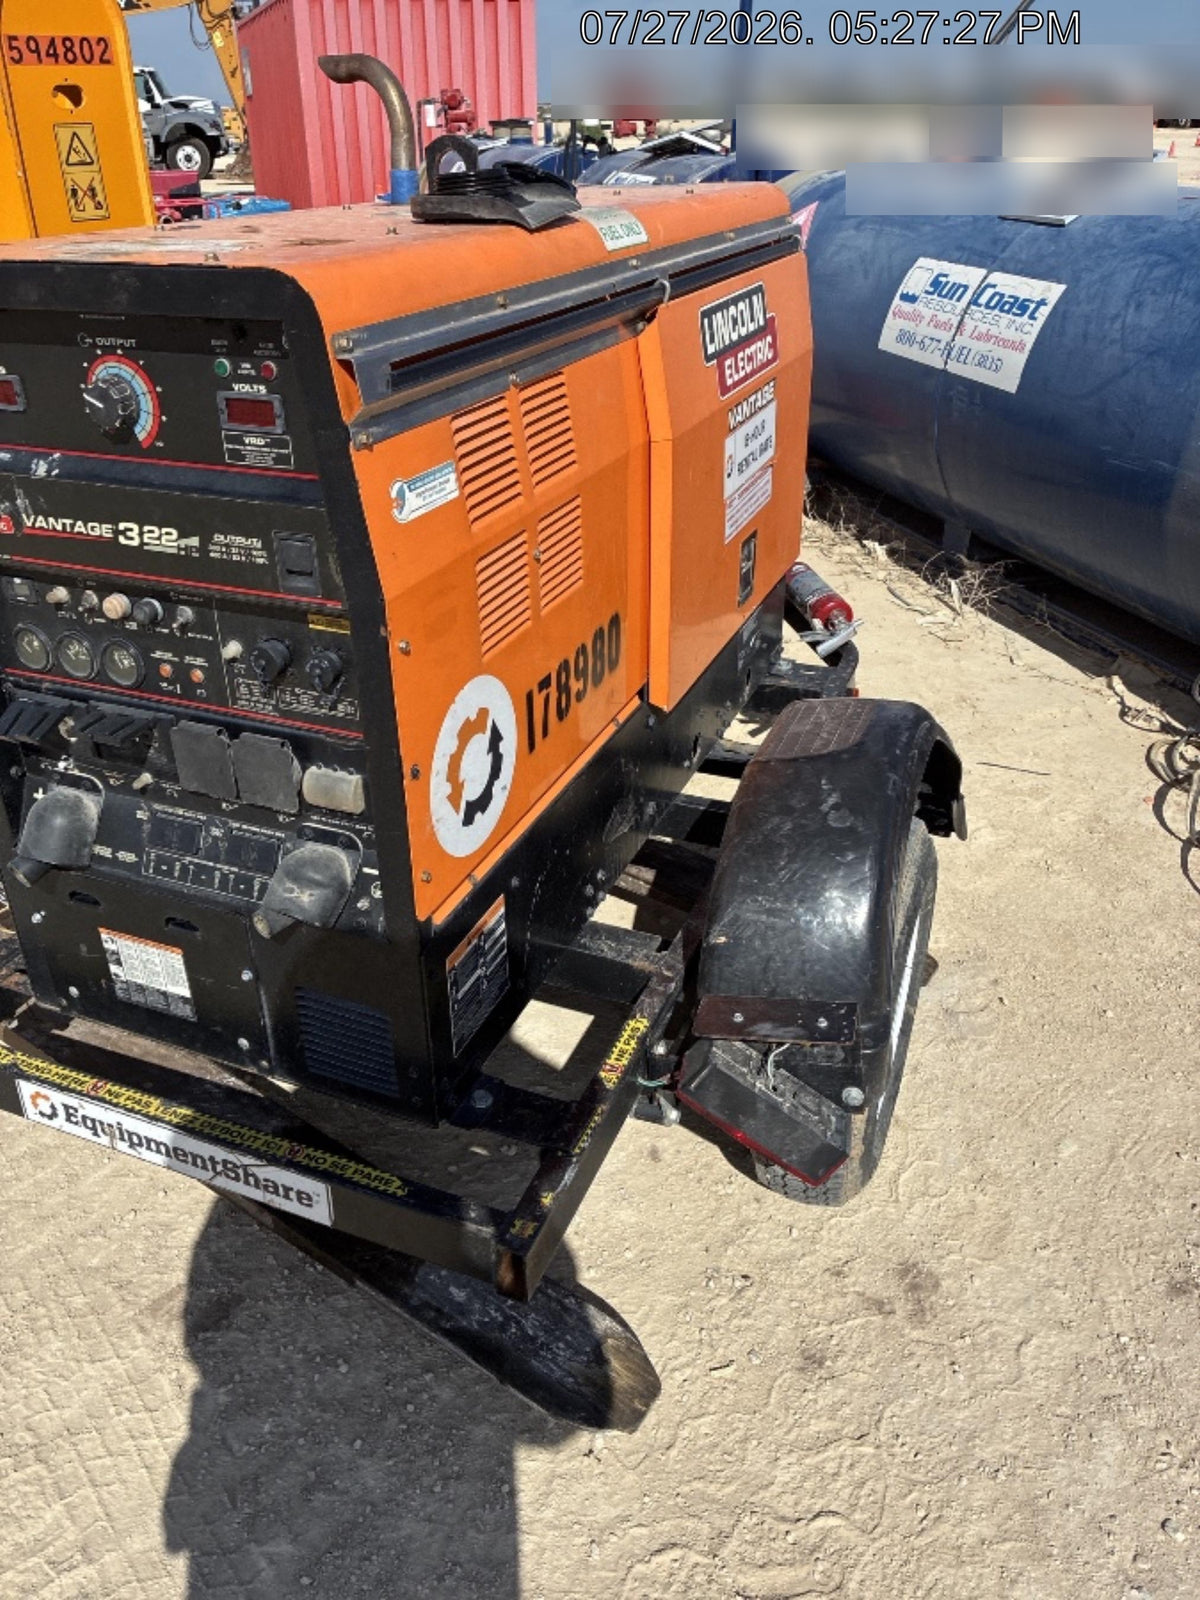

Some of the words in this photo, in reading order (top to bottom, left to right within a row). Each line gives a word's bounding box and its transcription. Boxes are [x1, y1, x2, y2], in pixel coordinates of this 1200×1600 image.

[7, 35, 112, 65] 594802
[925, 272, 970, 303] Sun
[970, 282, 1048, 321] Coast
[95, 337, 137, 348] OUTPUT
[704, 293, 765, 355] LINCOLN
[892, 303, 925, 327] Quality
[927, 313, 954, 333] Fuels
[968, 324, 1027, 354] Lubricants
[724, 335, 775, 387] ELECTRIC
[232, 383, 268, 394] VOLTS
[727, 381, 776, 430] VANTAGE
[22, 513, 115, 538] VANTAGE
[118, 521, 179, 547] 322
[526, 611, 622, 755] 178980
[61, 1102, 315, 1208] EquipmentShare
[125, 1094, 152, 1109] PAS
[199, 1119, 260, 1144] DEBOUT
[303, 1152, 327, 1166] NO
[329, 1159, 351, 1173] SE
[351, 1166, 396, 1187] PARE
